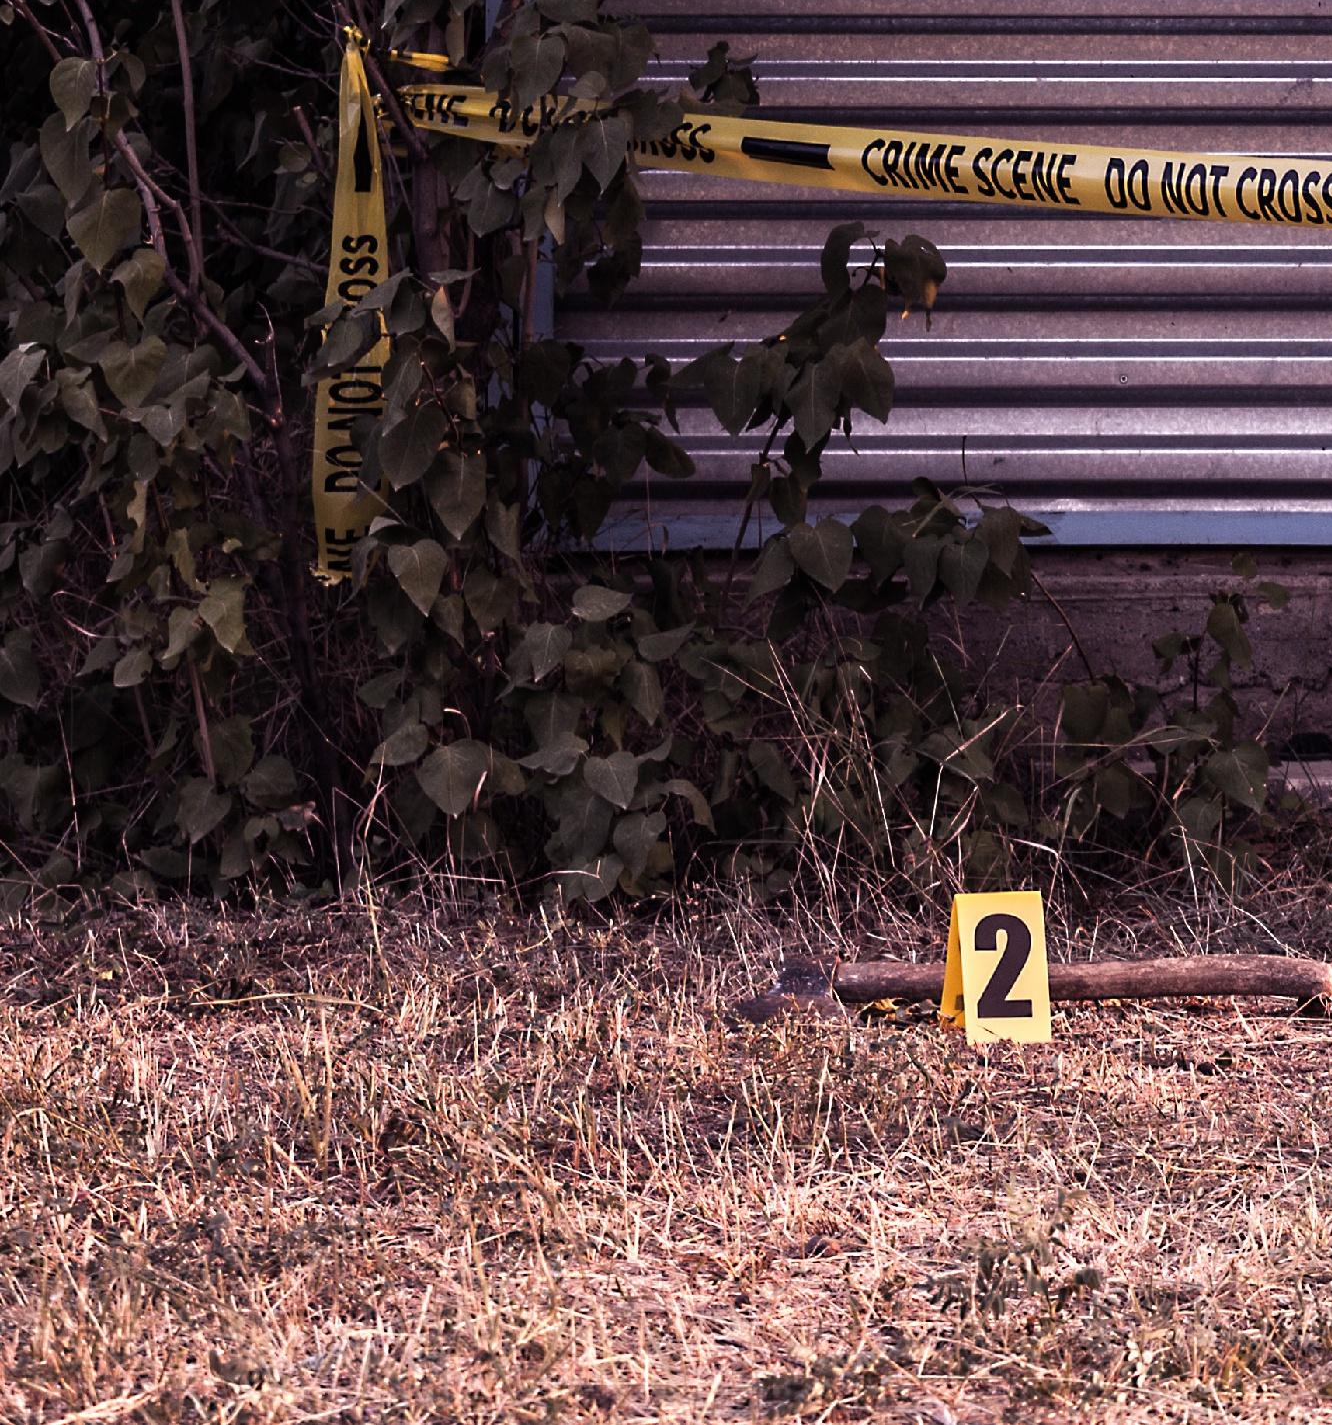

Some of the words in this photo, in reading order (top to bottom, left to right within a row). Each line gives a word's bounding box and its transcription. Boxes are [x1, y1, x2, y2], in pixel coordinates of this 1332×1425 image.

[861, 138, 966, 194] CRIME
[971, 146, 1081, 206] SCENE
[1104, 157, 1152, 212] DO
[1160, 161, 1230, 217] NOT
[974, 913, 1033, 1019] 2
